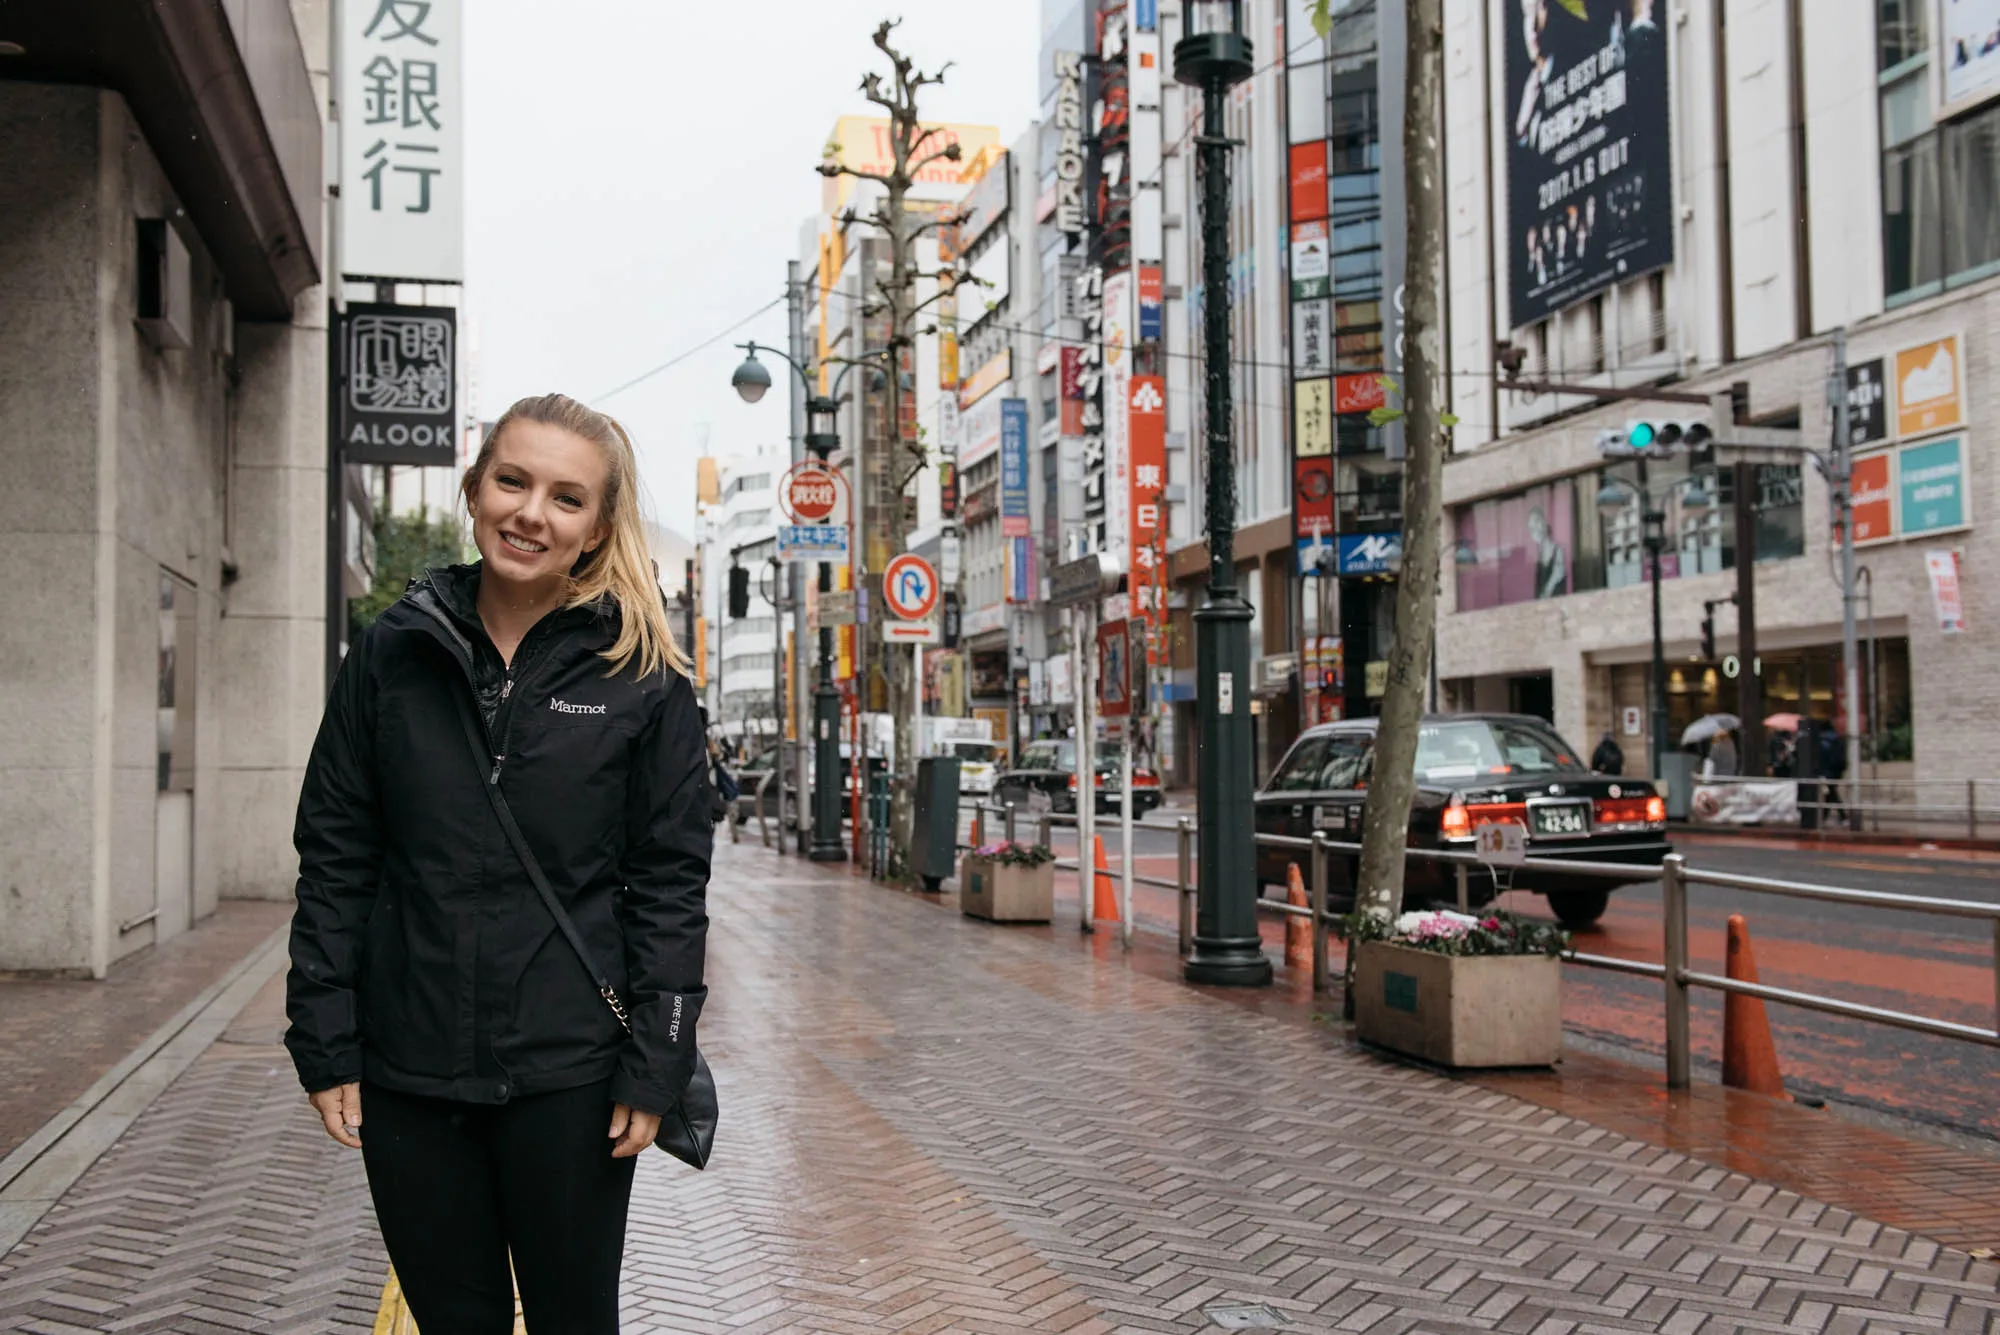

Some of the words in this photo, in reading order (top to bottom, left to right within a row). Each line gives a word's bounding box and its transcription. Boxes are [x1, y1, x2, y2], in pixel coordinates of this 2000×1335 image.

[1544, 74, 1567, 110] THE
[1567, 54, 1597, 95] BEST
[1055, 52, 1083, 232] KARAOKE
[1538, 156, 1596, 211] 2017.1.6
[1598, 136, 1630, 176] OUT
[350, 423, 451, 446] ALOOK
[550, 697, 606, 714] Marmot
